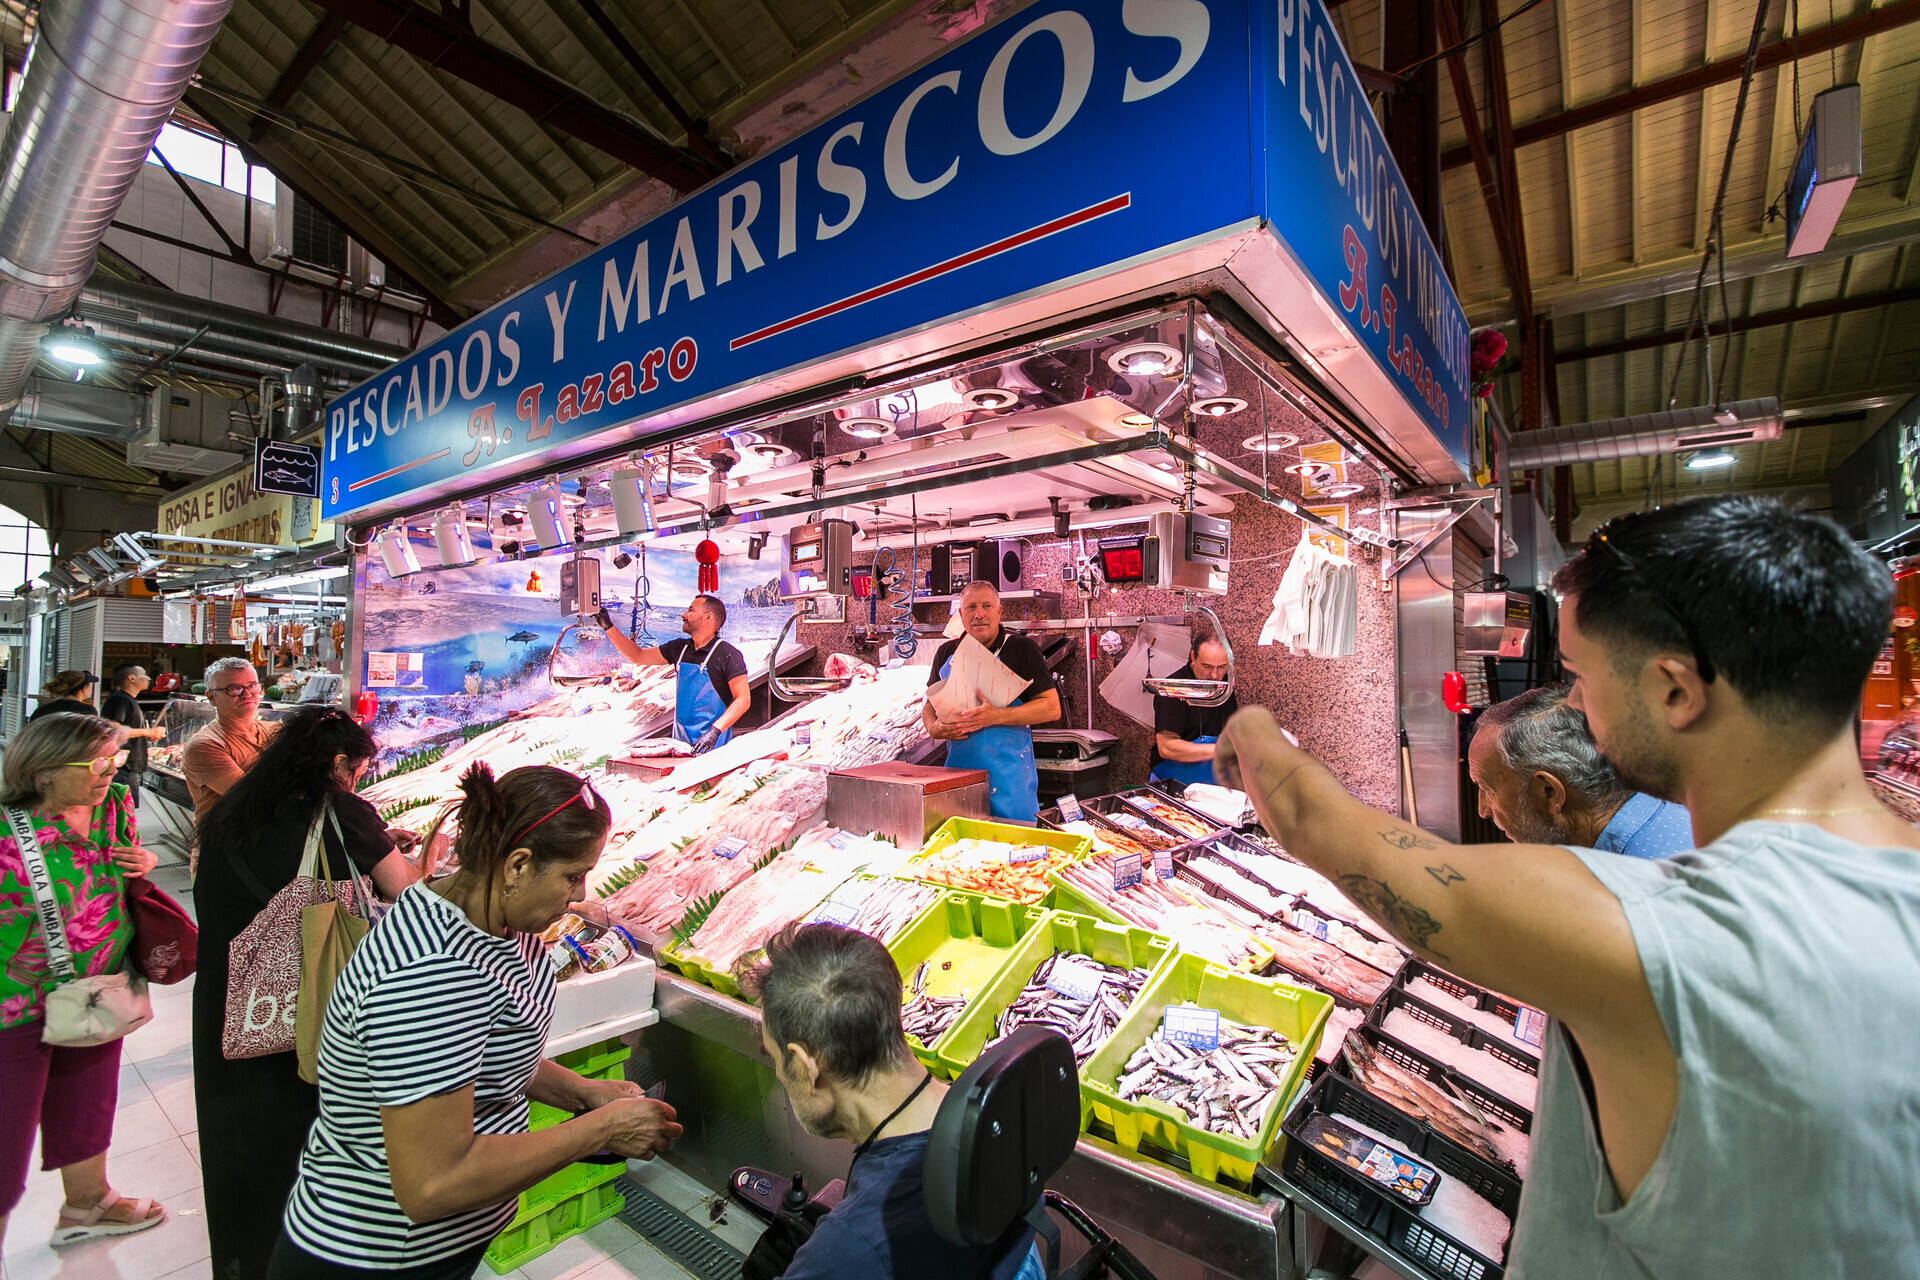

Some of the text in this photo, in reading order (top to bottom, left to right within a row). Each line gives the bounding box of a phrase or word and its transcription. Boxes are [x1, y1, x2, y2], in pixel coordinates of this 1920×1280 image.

[330, 0, 1211, 462] PESCADOS Y MARISCOS
[1278, 0, 1468, 401] PESCADOS Y MARISCOS
[1338, 223, 1449, 429] A. Lazaro
[463, 336, 699, 467] A. Lazaro
[165, 498, 201, 533] ROSA
[204, 491, 215, 520] E
[330, 477, 339, 504] 3
[8, 807, 38, 853] BIMBAY
[28, 858, 48, 891] LOLA
[41, 899, 65, 950] BIMBAY
